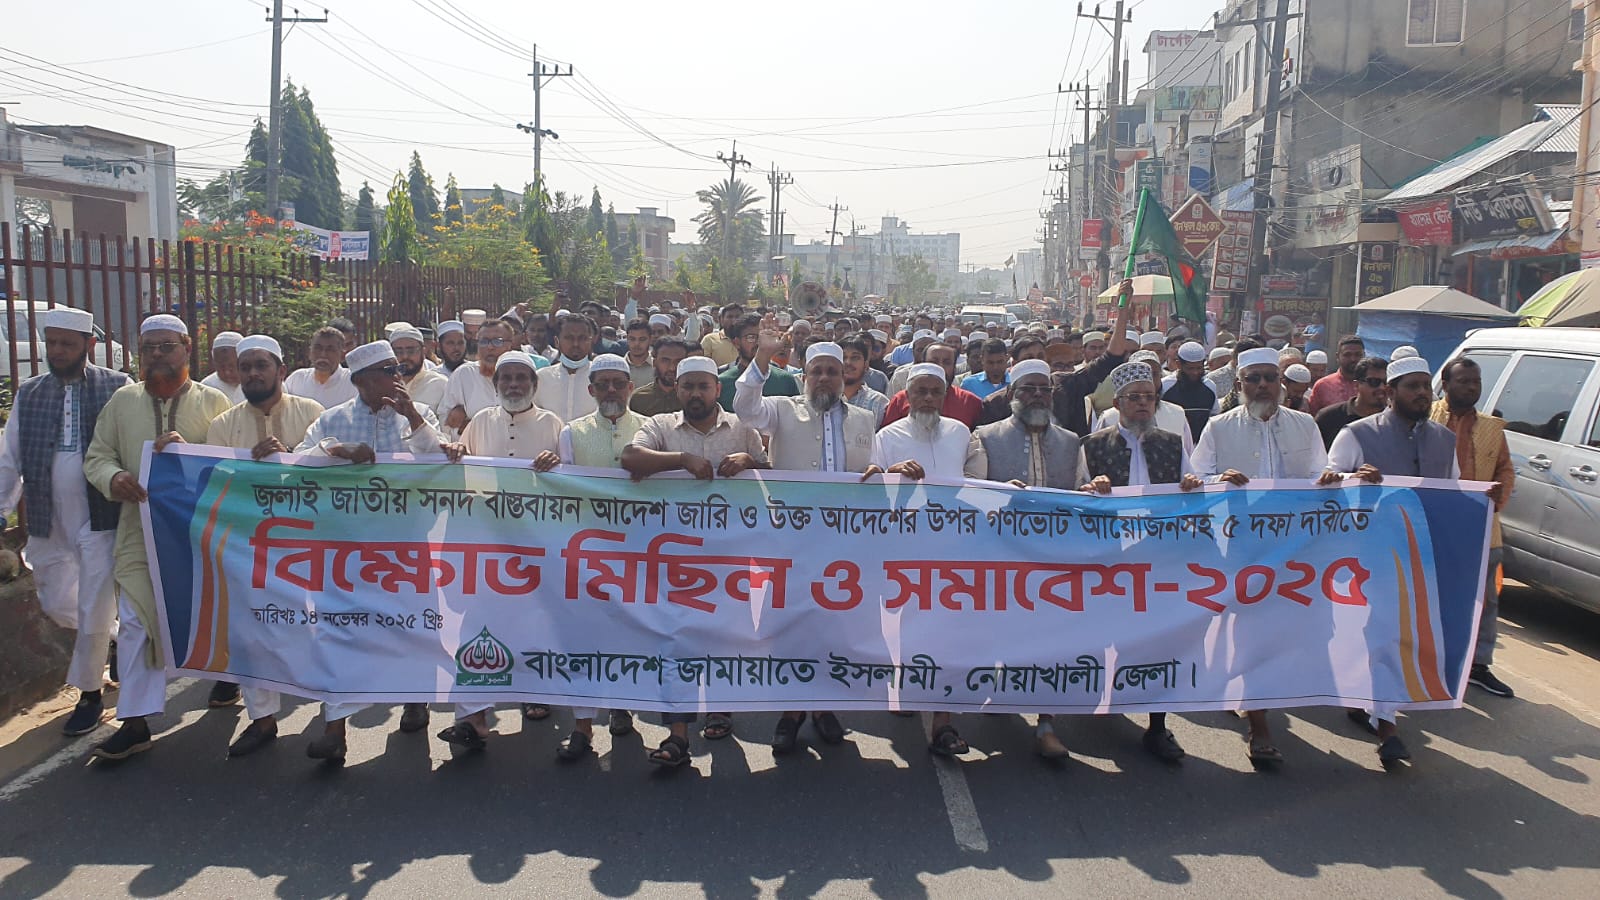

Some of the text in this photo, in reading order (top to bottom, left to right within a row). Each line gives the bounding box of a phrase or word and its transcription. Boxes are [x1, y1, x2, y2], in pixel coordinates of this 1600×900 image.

[252, 477, 1373, 541] জুলাই জাতীয় সনদ বাস্তবায়ন আদেশ জারি ও উক্ত আদেশের উপর গণভোট আয়োজনসহ ৫ দফা দাবীতে
[249, 516, 545, 595] বিক্ষোভ
[560, 528, 792, 613] মিছিল
[810, 560, 863, 611] ও
[251, 604, 295, 625] তারিখঃ
[300, 612, 318, 625] ১৪
[323, 612, 369, 628] নভেম্বর
[375, 613, 416, 629] ২০২৫
[521, 649, 667, 685] বাংলাদেশ
[677, 653, 819, 687] জামায়াতে
[966, 653, 1105, 693] নোয়াখালী
